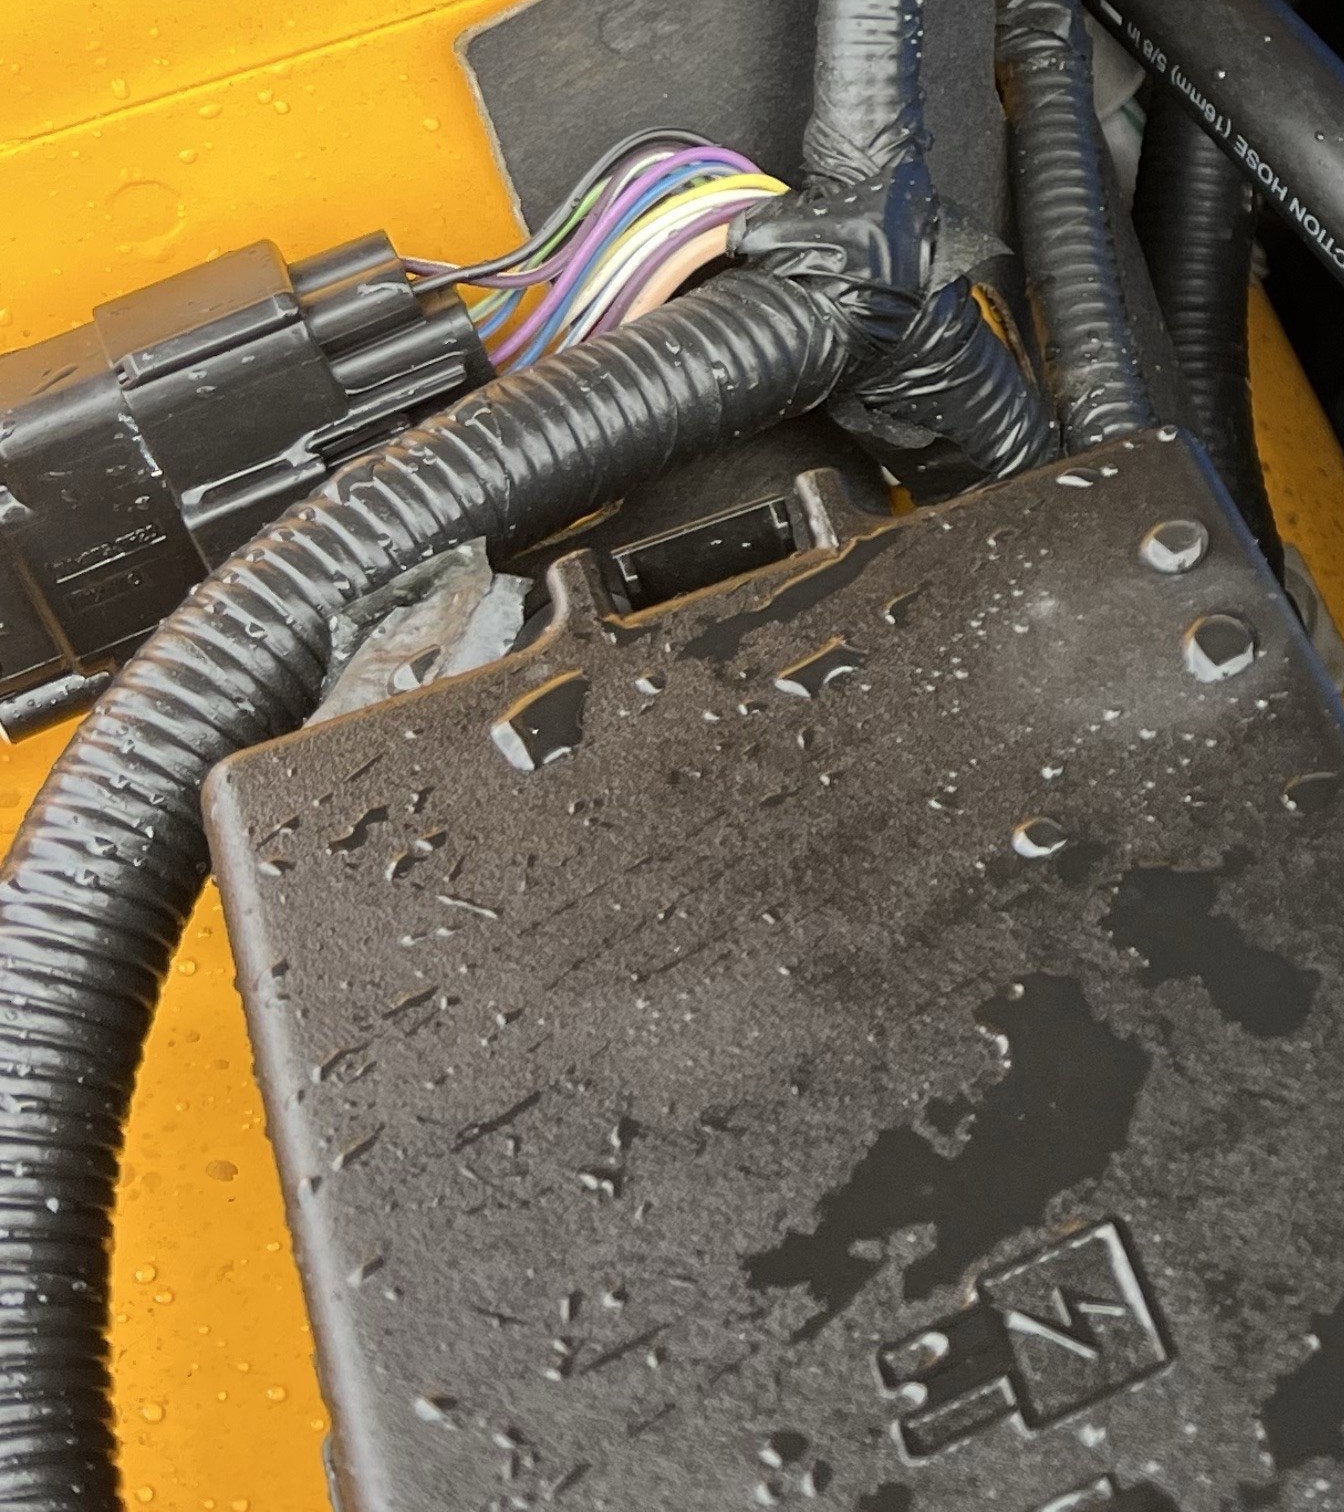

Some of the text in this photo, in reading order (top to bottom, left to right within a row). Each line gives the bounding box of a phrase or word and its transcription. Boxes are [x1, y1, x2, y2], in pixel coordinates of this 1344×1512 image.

[1126, 21, 1142, 48] in
[1142, 38, 1168, 74] 5/8
[1170, 64, 1231, 138] (16mm)
[1233, 134, 1288, 202] HOSE
